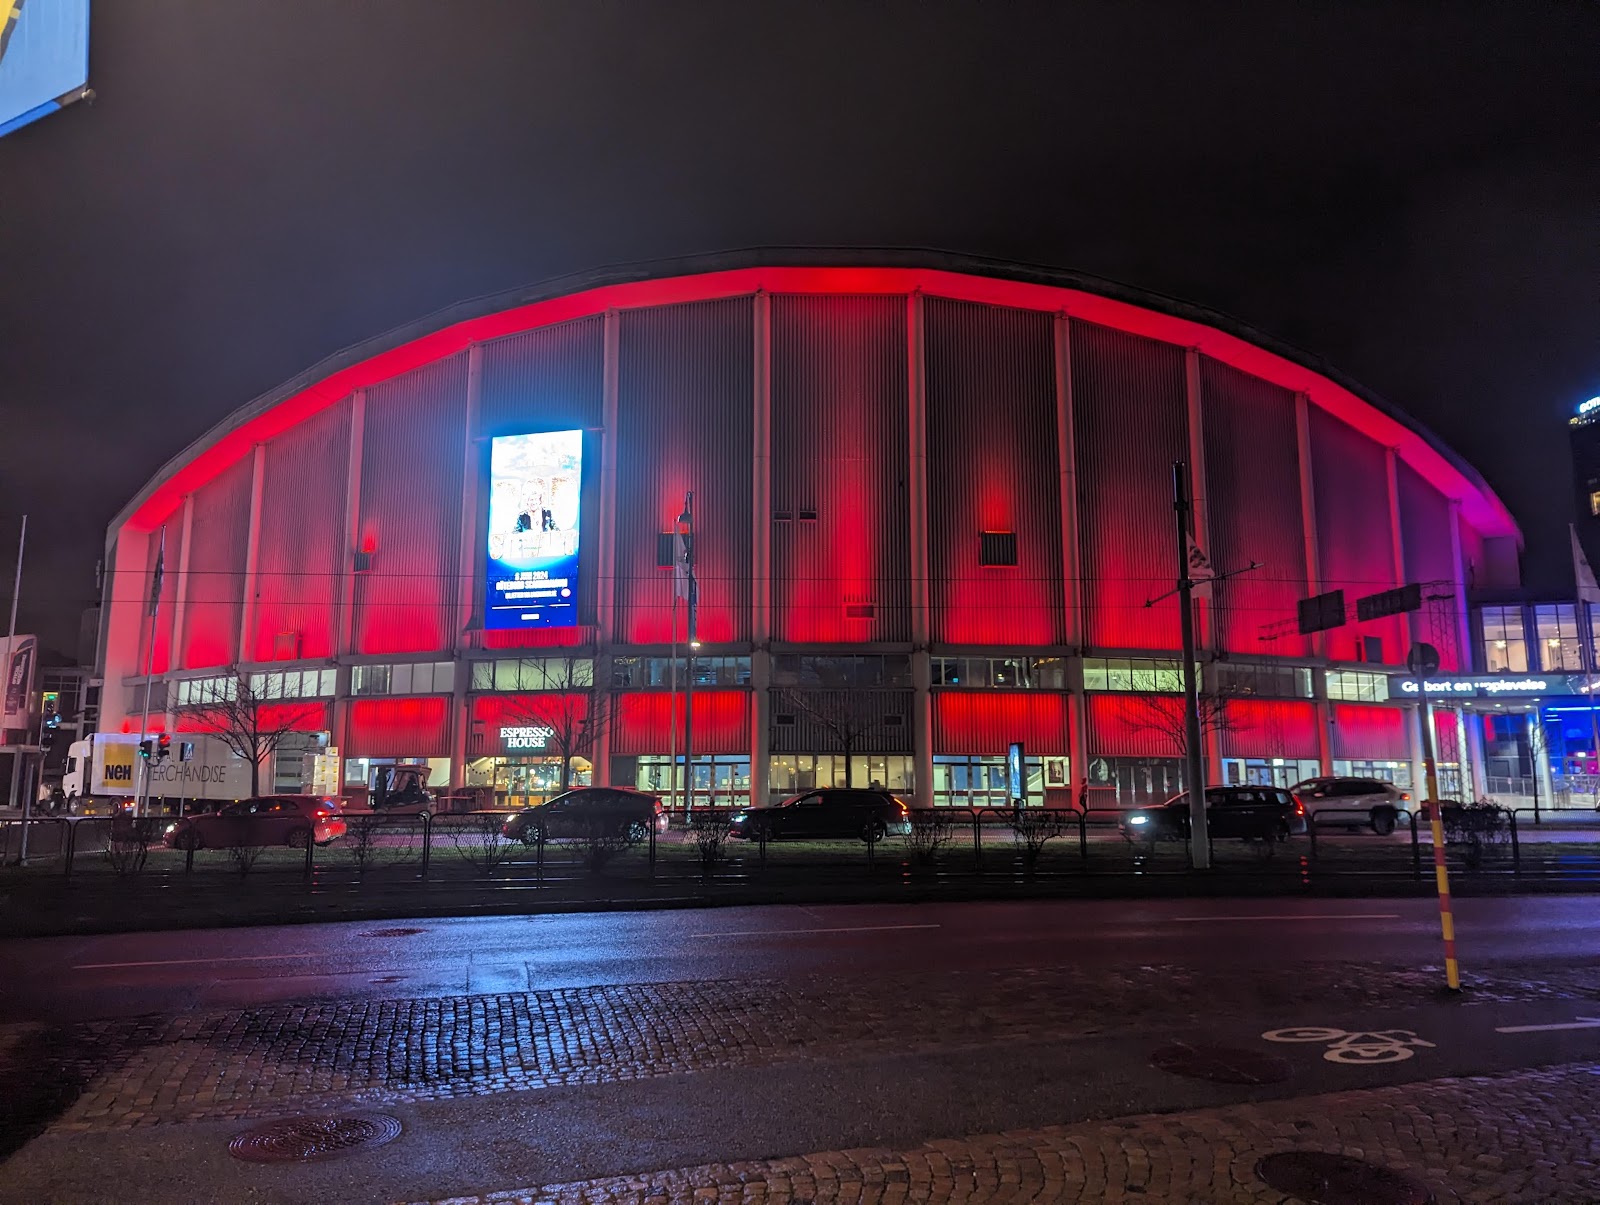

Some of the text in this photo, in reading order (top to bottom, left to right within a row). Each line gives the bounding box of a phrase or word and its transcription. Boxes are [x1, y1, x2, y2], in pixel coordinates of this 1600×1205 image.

[1424, 681, 1452, 691] bort
[1454, 682, 1472, 691] en
[500, 727, 554, 737] ESPRESSO
[507, 737, 545, 748] HOUSE
